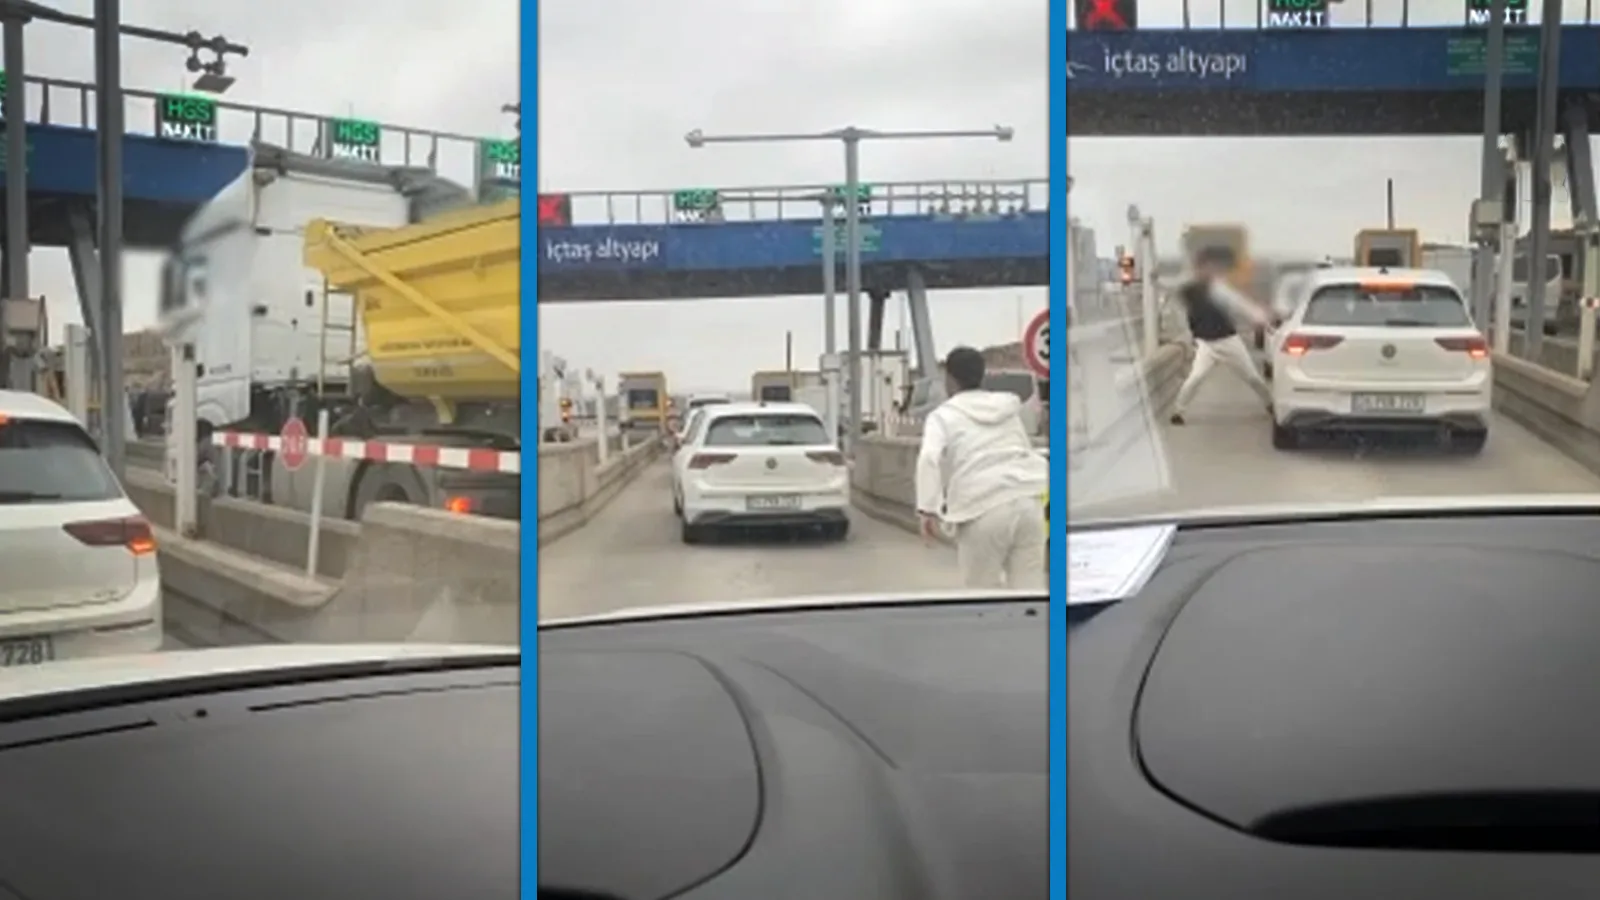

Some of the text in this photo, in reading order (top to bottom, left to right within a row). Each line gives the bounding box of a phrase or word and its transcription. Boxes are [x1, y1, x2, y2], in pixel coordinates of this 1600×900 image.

[1104, 46, 1246, 80] içtaş altyapı
[167, 99, 211, 121] HGS
[340, 121, 376, 143] HGS
[546, 237, 659, 263] içtaş altyapı
